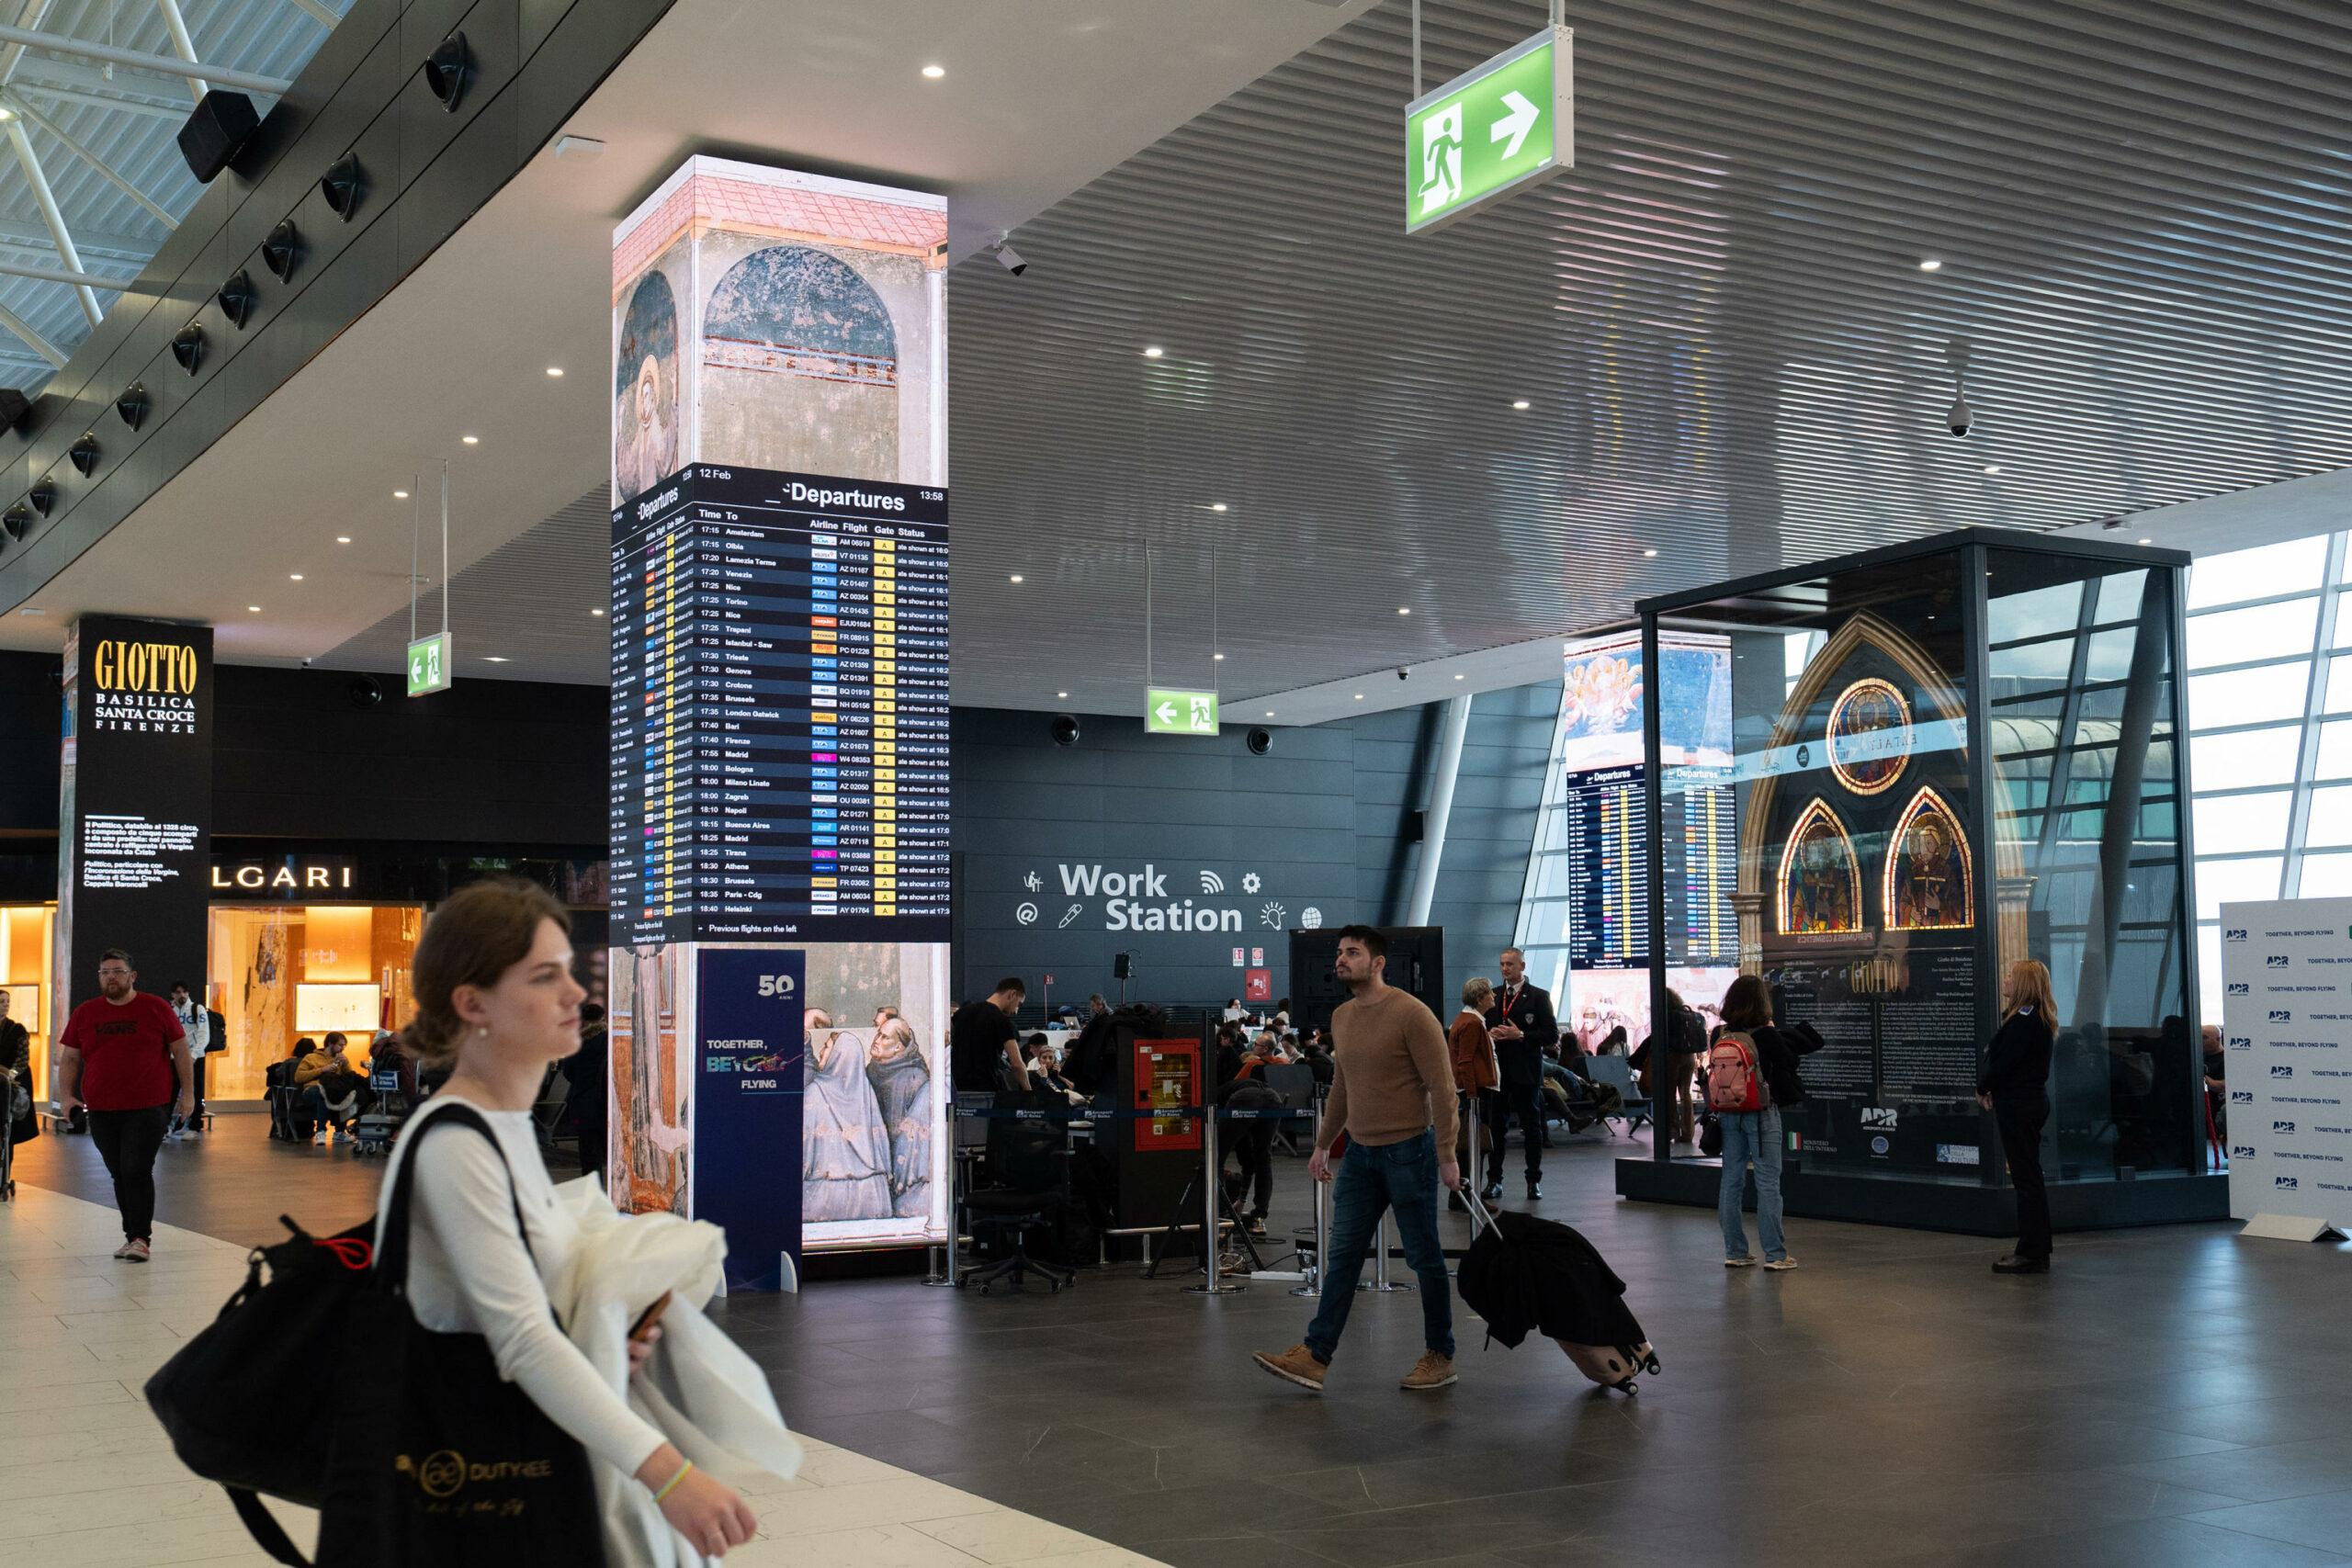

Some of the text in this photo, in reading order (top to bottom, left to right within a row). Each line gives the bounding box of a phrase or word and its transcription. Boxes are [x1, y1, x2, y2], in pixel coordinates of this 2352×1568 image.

[700, 468, 731, 479] 12 Feb
[791, 482, 906, 511] Departures
[920, 491, 943, 501] 13:58
[639, 487, 678, 520] Departures
[699, 509, 925, 537] Time To Airline Flight Gate Status
[726, 529, 764, 537] Amsterdam
[726, 626, 751, 634] Trapani
[95, 640, 197, 694] GIOTTO
[96, 693, 195, 708] BASILICA
[96, 707, 194, 722] SANTA CROCE
[96, 720, 194, 733] FIRENZE
[1594, 770, 1630, 782] Departures
[1059, 864, 1167, 897] Work
[1107, 899, 1241, 931] Station
[741, 925, 761, 933] flights
[2227, 930, 2247, 939] ADR
[2267, 956, 2288, 965] ADR
[1852, 960, 1898, 993] GIOTTO
[758, 975, 794, 996] 50
[2228, 984, 2249, 992] ADR
[2269, 1011, 2290, 1020] ADR
[707, 1040, 767, 1050] TOGETHER,
[706, 1056, 785, 1072] BEYO
[742, 1080, 776, 1089] FLYING
[2232, 1092, 2253, 1101] ADR
[1861, 1108, 1897, 1127] ADR
[2234, 1146, 2255, 1156] ADR
